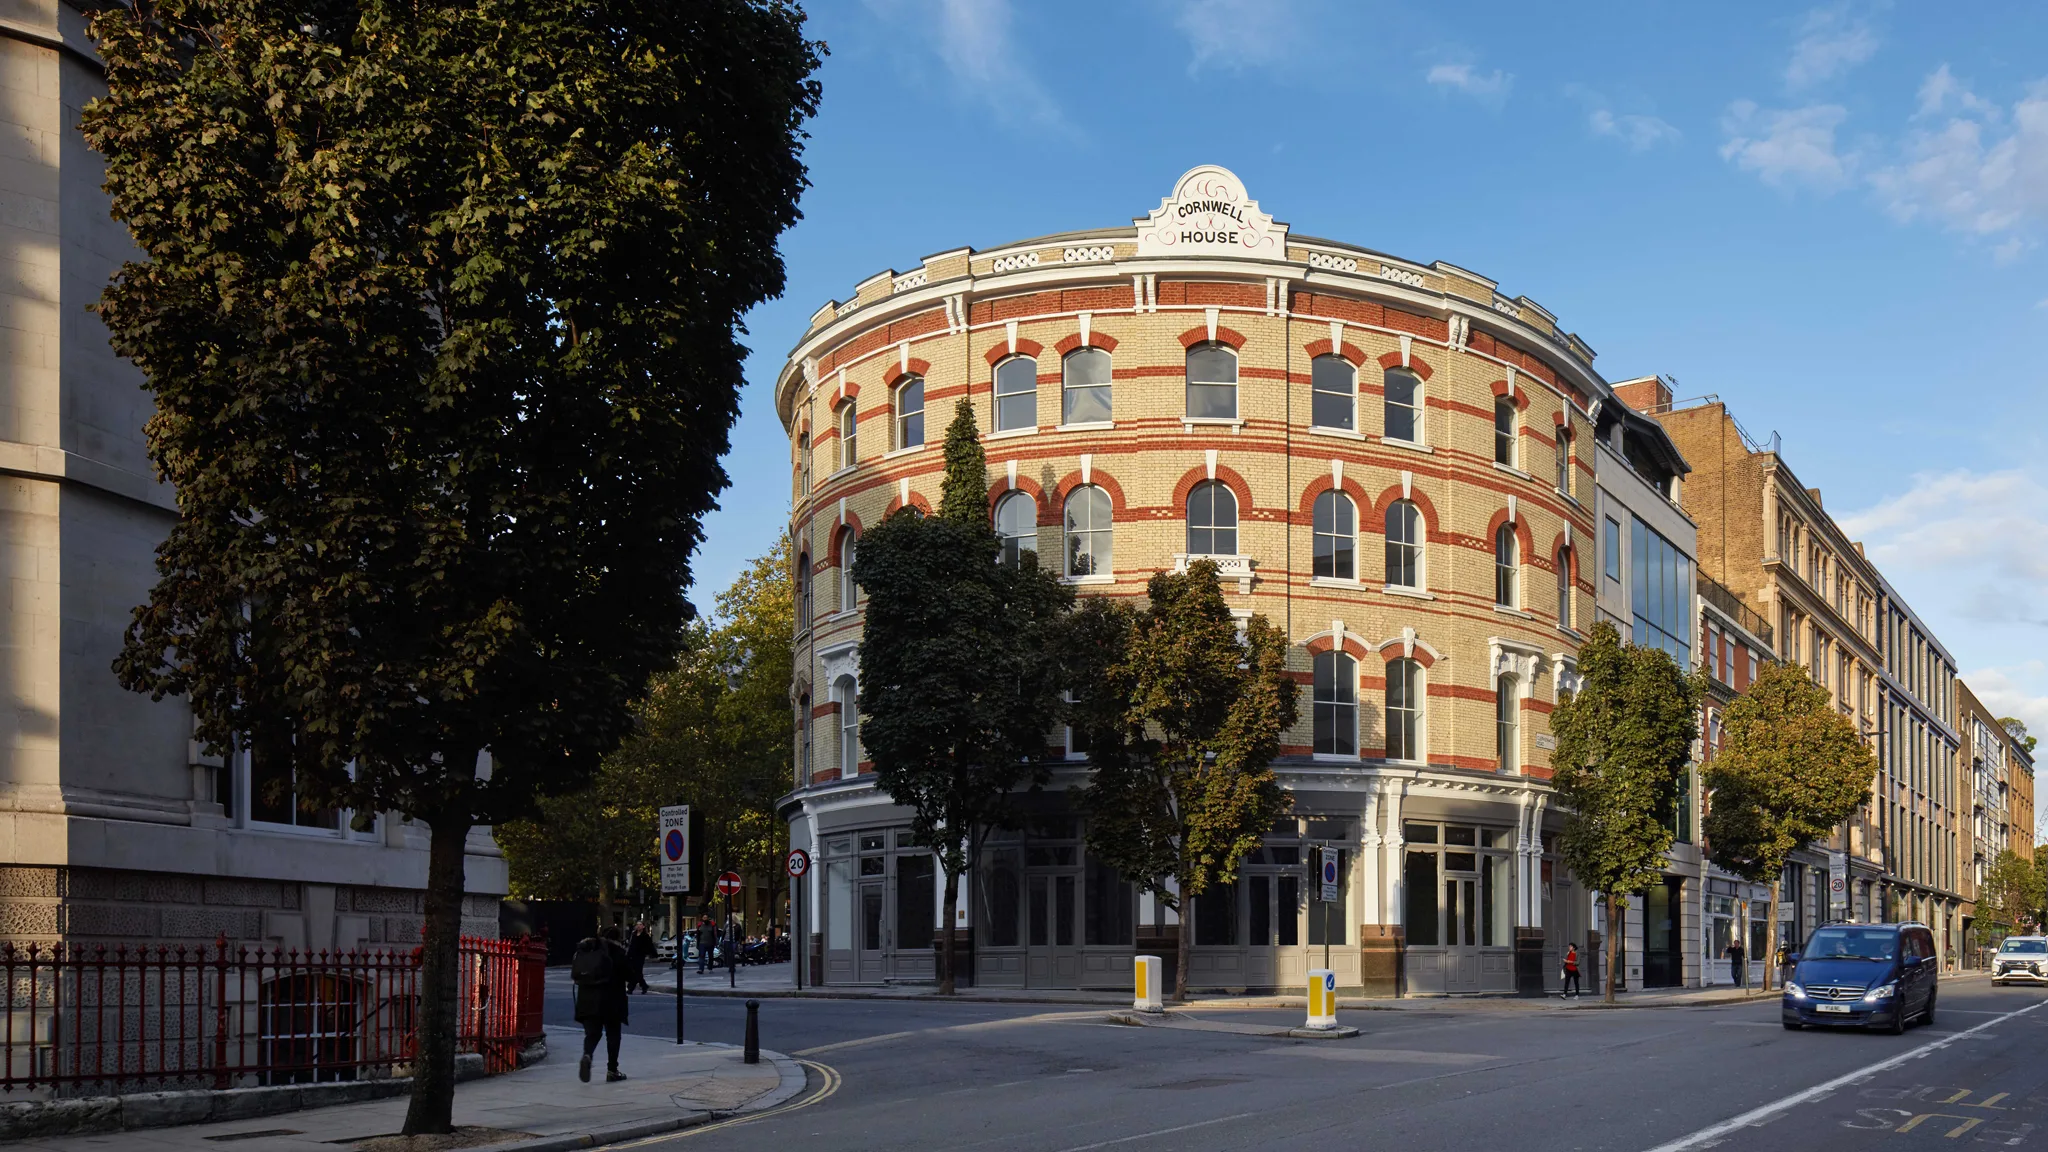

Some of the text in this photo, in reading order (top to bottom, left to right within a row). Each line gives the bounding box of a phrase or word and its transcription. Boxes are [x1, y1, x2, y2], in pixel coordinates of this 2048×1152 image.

[1178, 200, 1243, 223] CORNWELL
[1181, 231, 1239, 244] HOUSE
[661, 808, 688, 817] Controlled
[665, 817, 684, 827] ZONE
[790, 858, 803, 869] 20
[1833, 881, 1843, 889] 20
